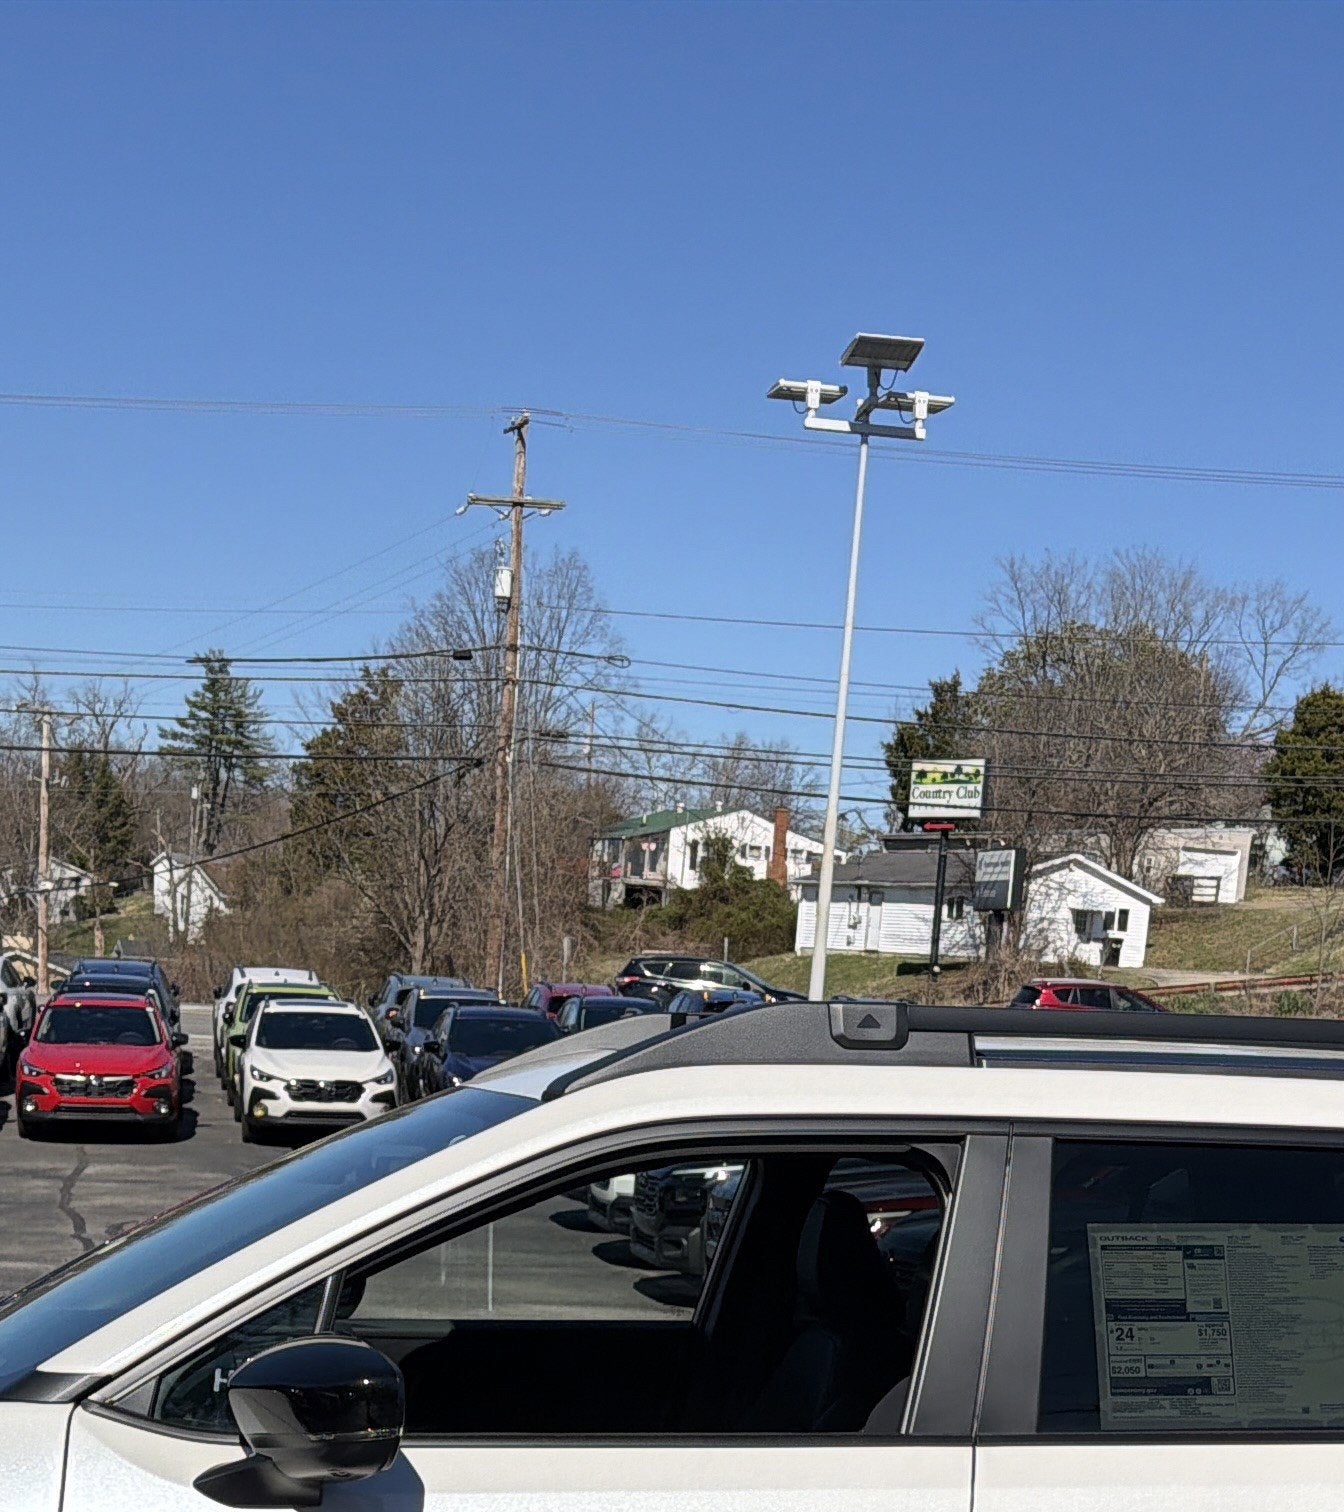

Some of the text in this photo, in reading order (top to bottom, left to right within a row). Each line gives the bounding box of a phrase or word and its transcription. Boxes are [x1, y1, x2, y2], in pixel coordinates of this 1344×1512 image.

[911, 785, 980, 803] Country Club
[1115, 1327, 1135, 1341] 24
[1198, 1328, 1227, 1338] $1,750
[1111, 1366, 1141, 1376] $2,050
